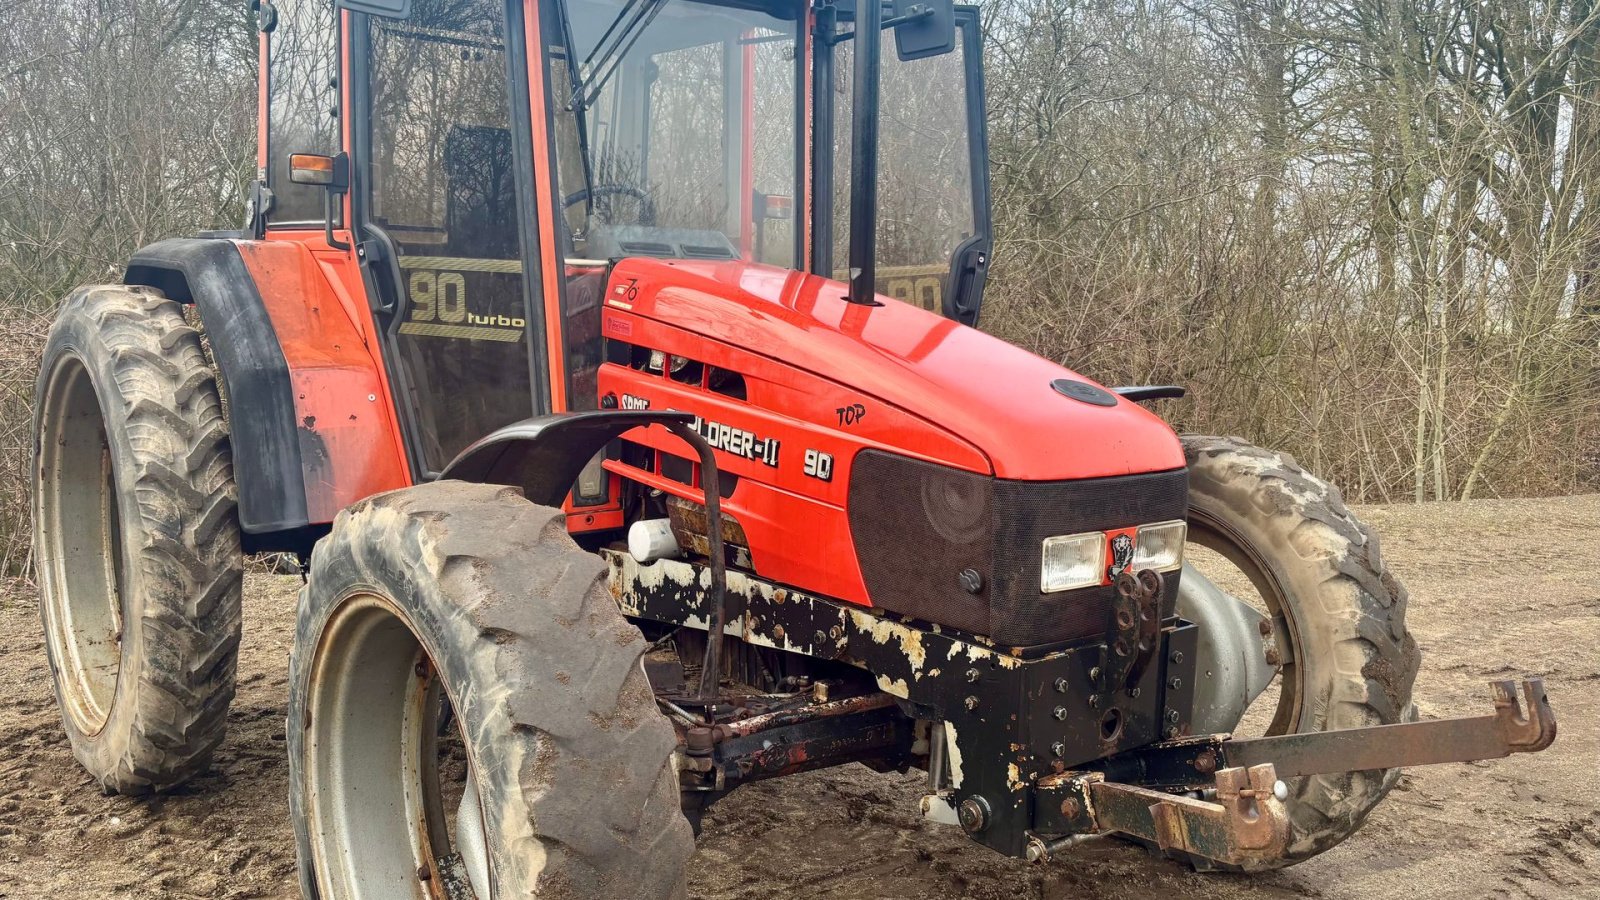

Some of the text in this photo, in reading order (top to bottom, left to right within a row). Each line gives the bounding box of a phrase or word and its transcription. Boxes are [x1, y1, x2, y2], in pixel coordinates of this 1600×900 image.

[410, 271, 525, 327] 90 turbo
[666, 408, 778, 466] PLORER-II
[836, 404, 866, 427] TOP
[803, 448, 833, 481] 90
